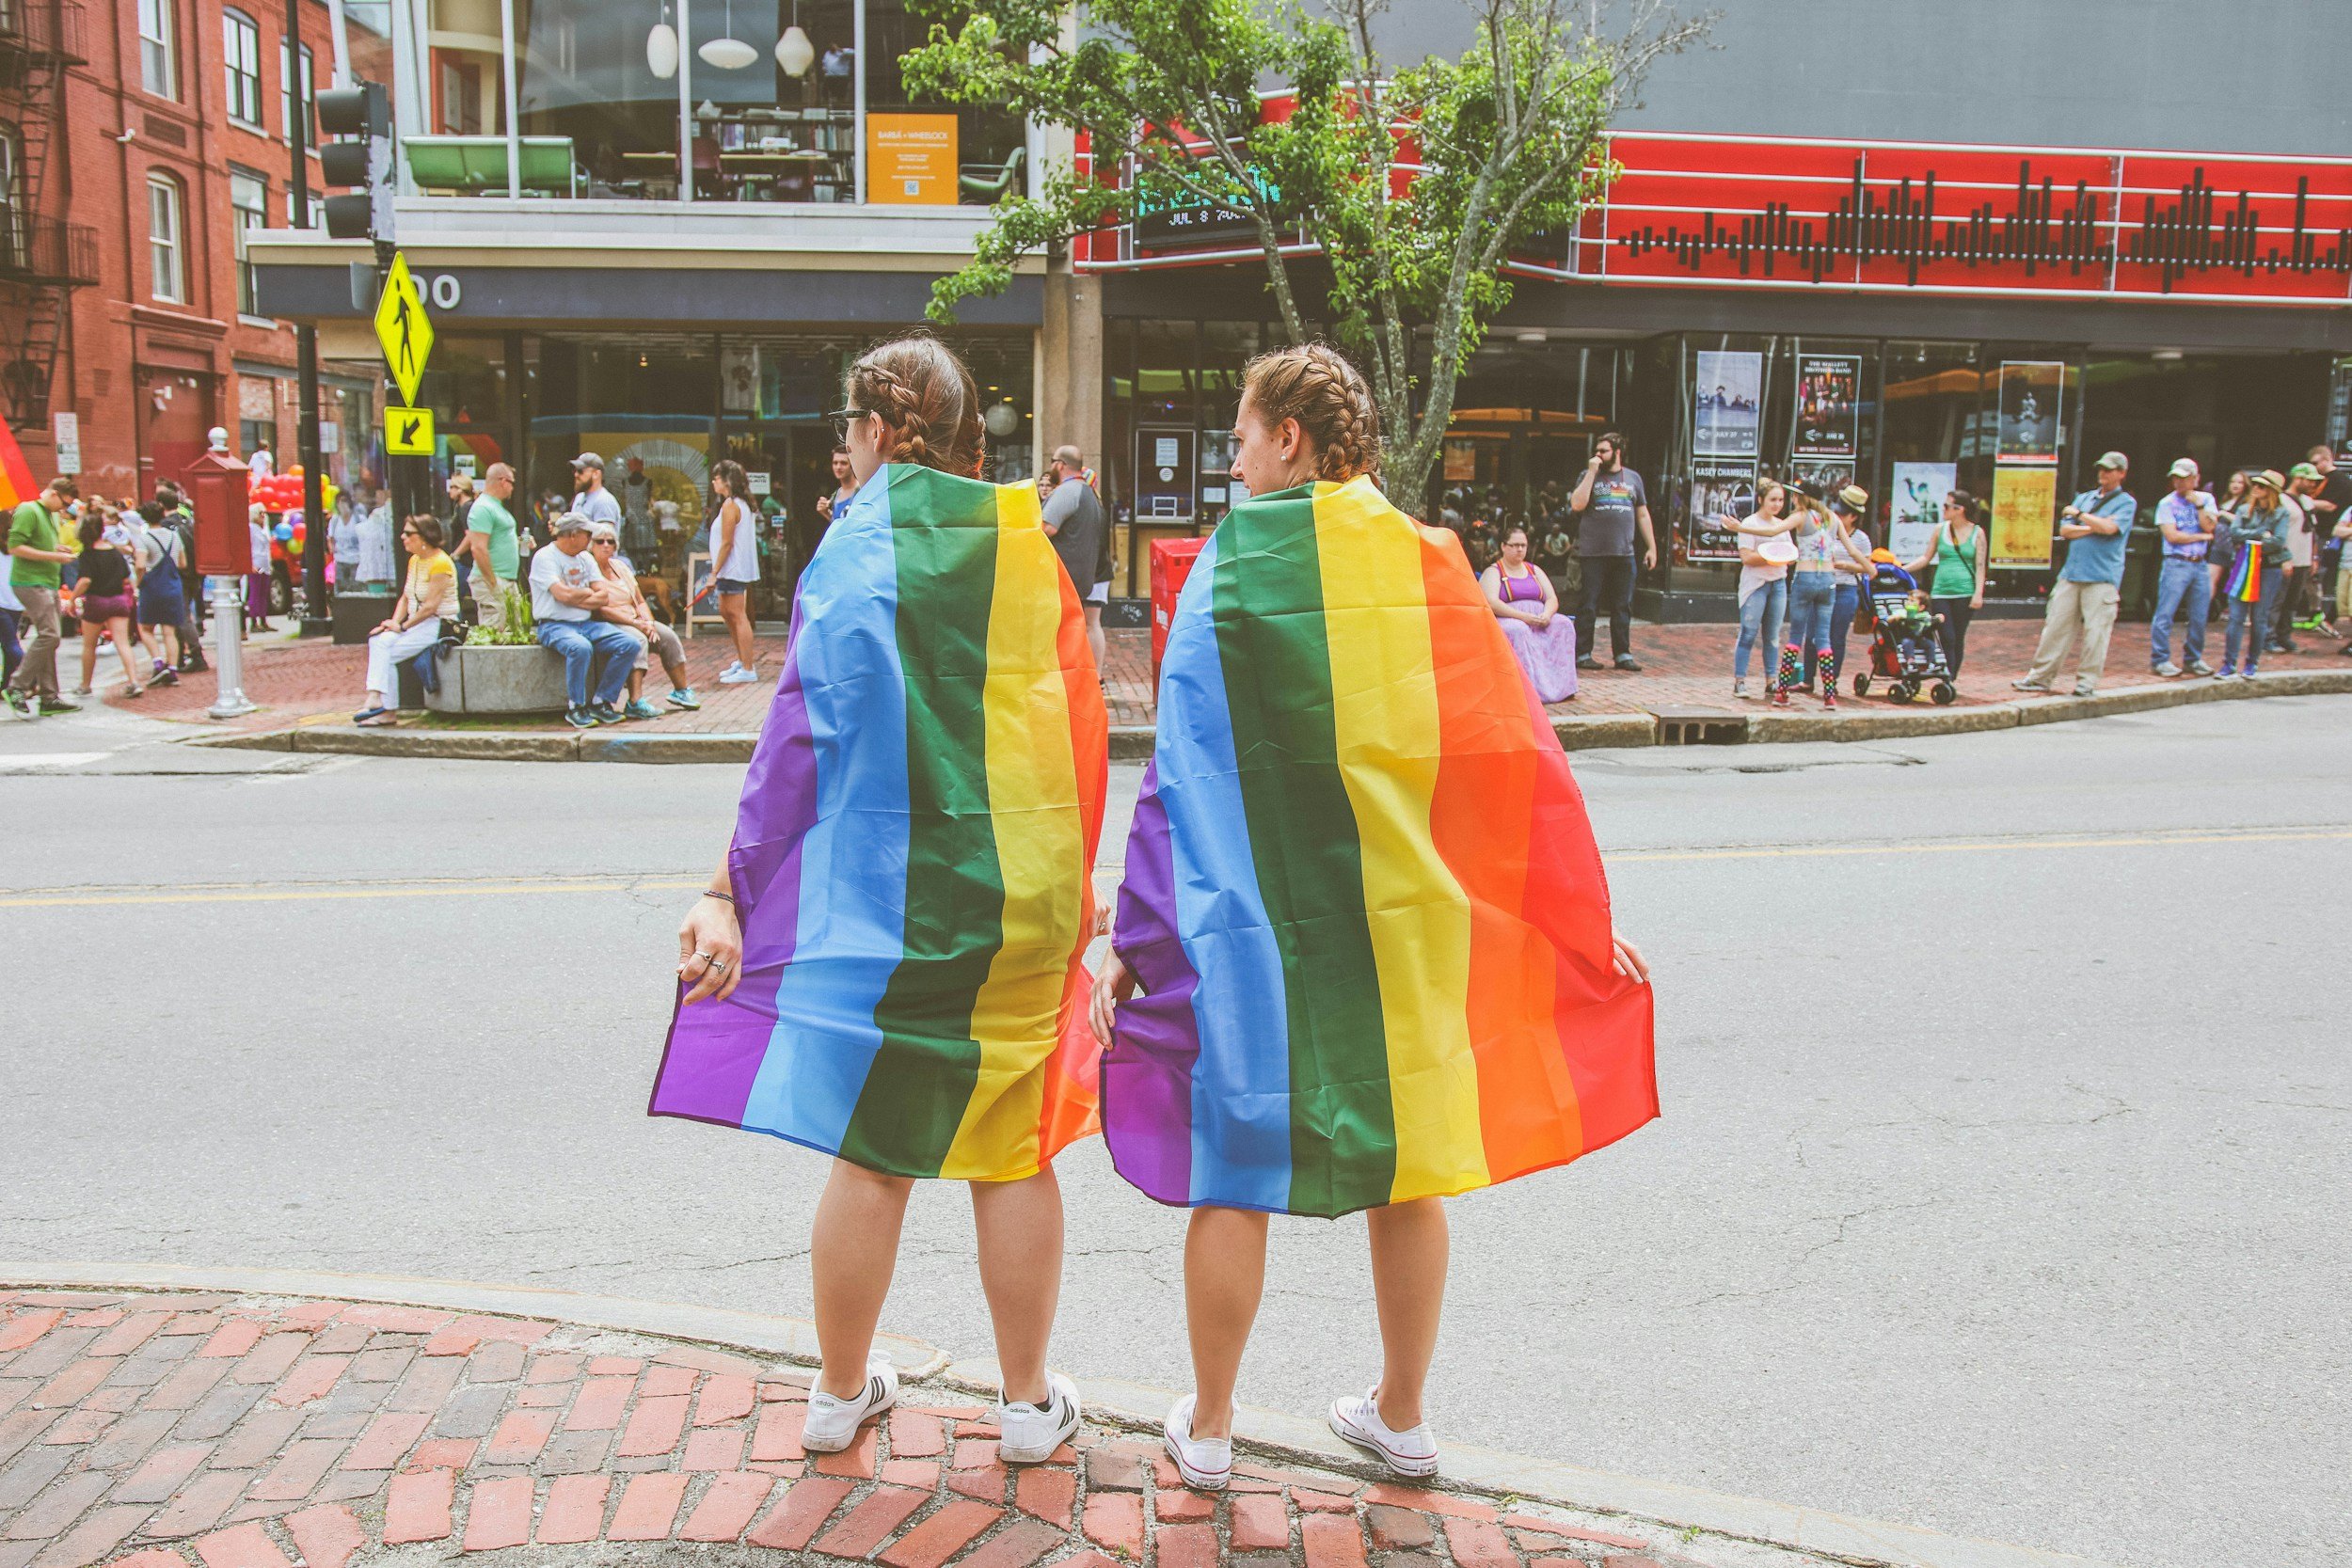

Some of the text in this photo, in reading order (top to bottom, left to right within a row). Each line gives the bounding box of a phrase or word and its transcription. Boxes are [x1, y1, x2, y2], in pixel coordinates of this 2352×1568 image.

[1168, 212, 1193, 226] JUL
[1200, 210, 1209, 223] 8
[1695, 467, 1754, 478] KASEY CHAMBERS
